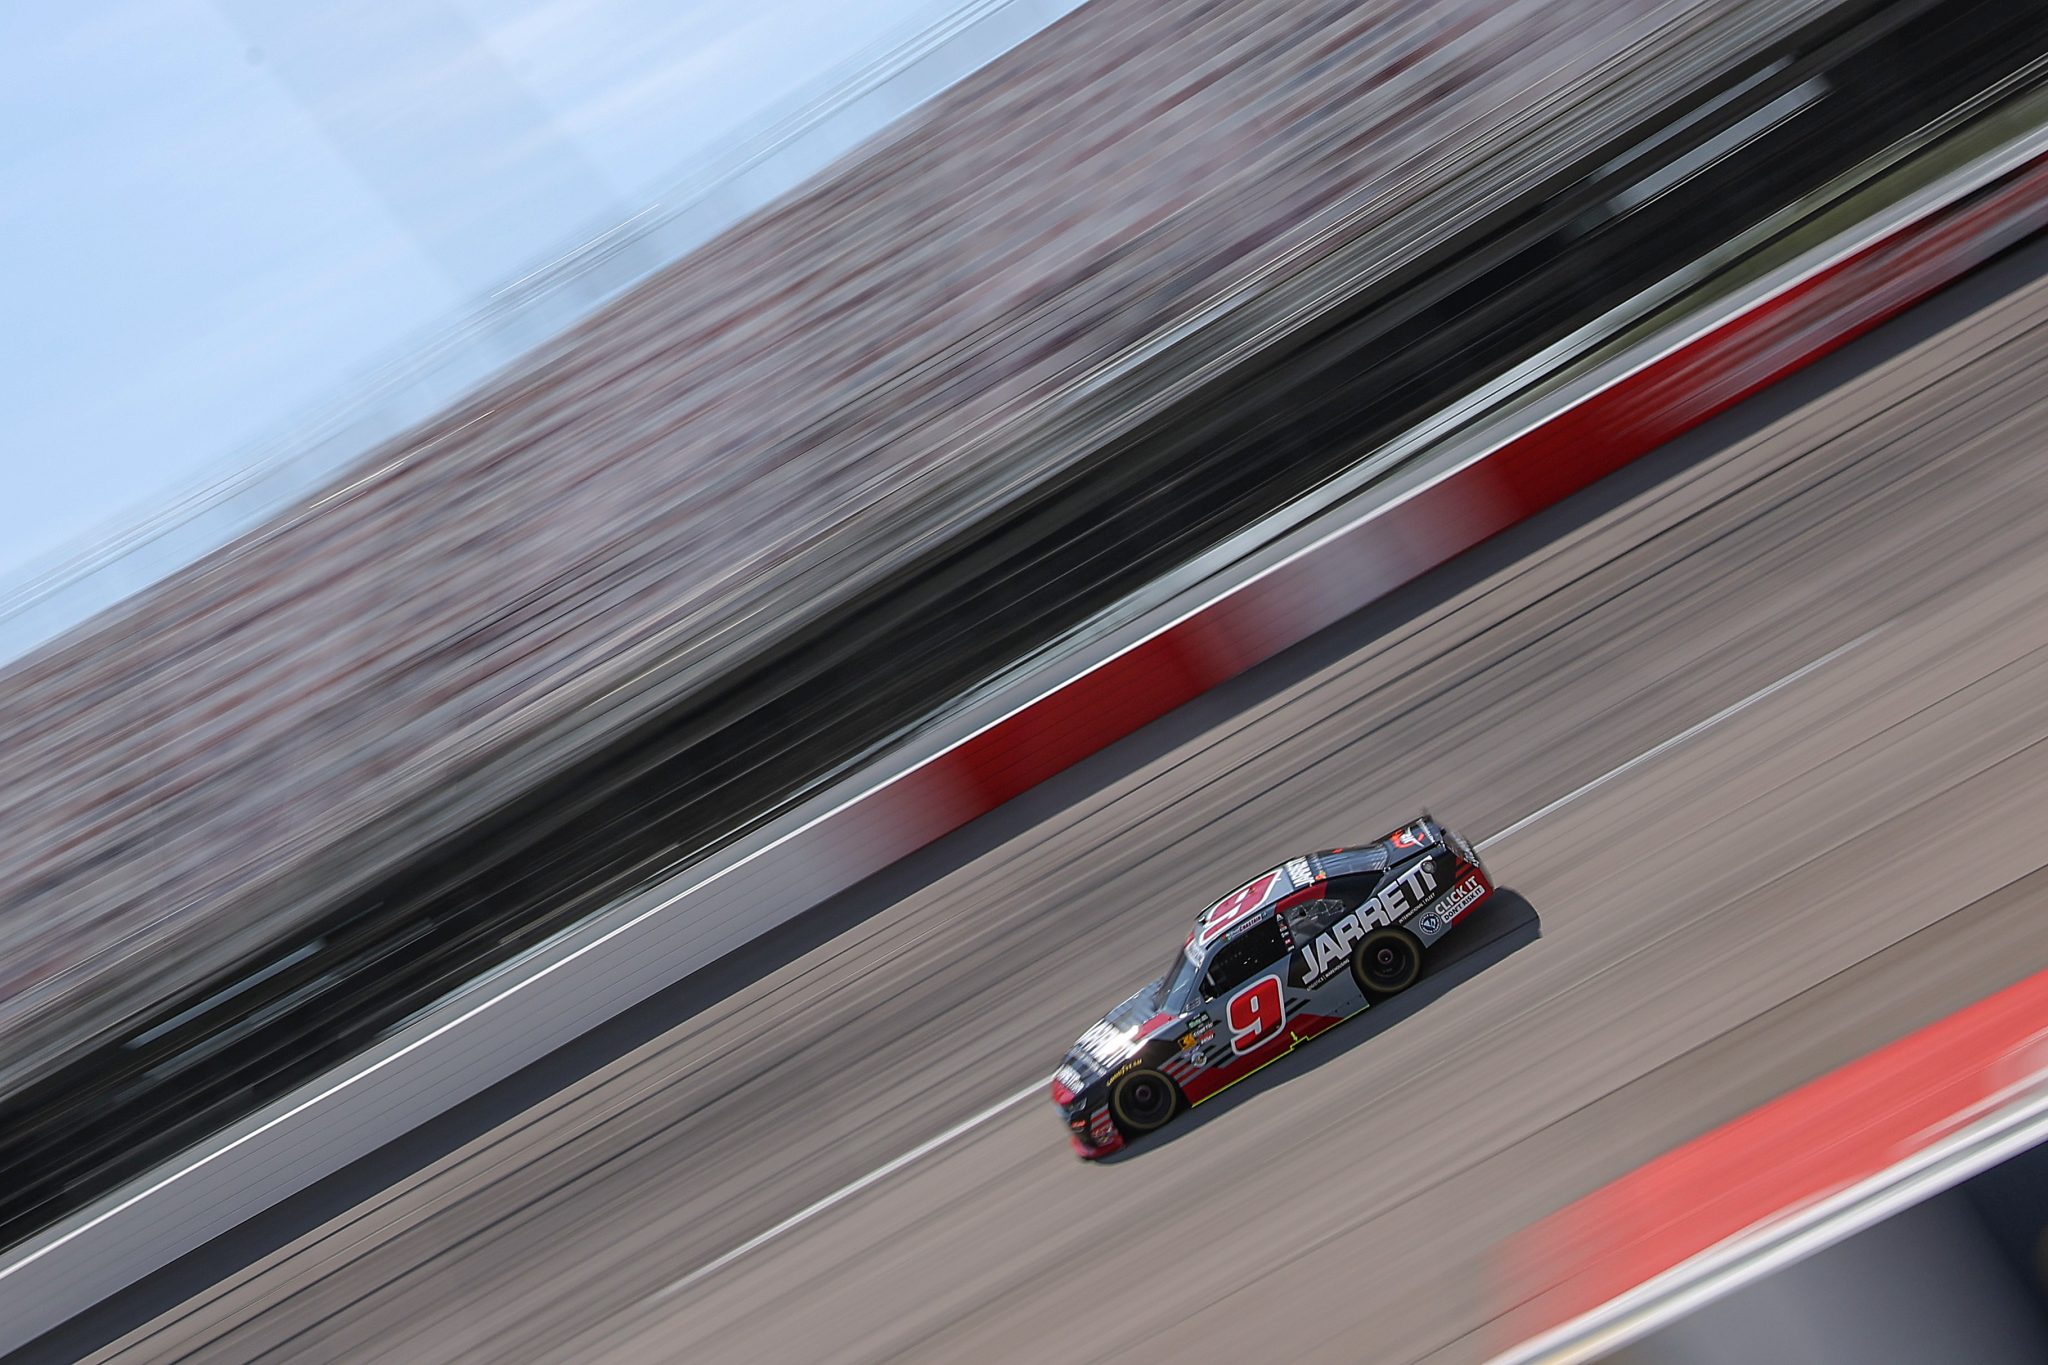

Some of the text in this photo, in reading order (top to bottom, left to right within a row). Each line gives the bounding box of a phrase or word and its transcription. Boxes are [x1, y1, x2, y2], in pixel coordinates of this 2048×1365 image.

[1301, 855, 1437, 985] JARRETT
[1435, 876, 1478, 915] CLICK IT
[1444, 904, 1462, 921] DON'T
[1462, 893, 1476, 906] RISK
[1226, 973, 1287, 1056] 9
